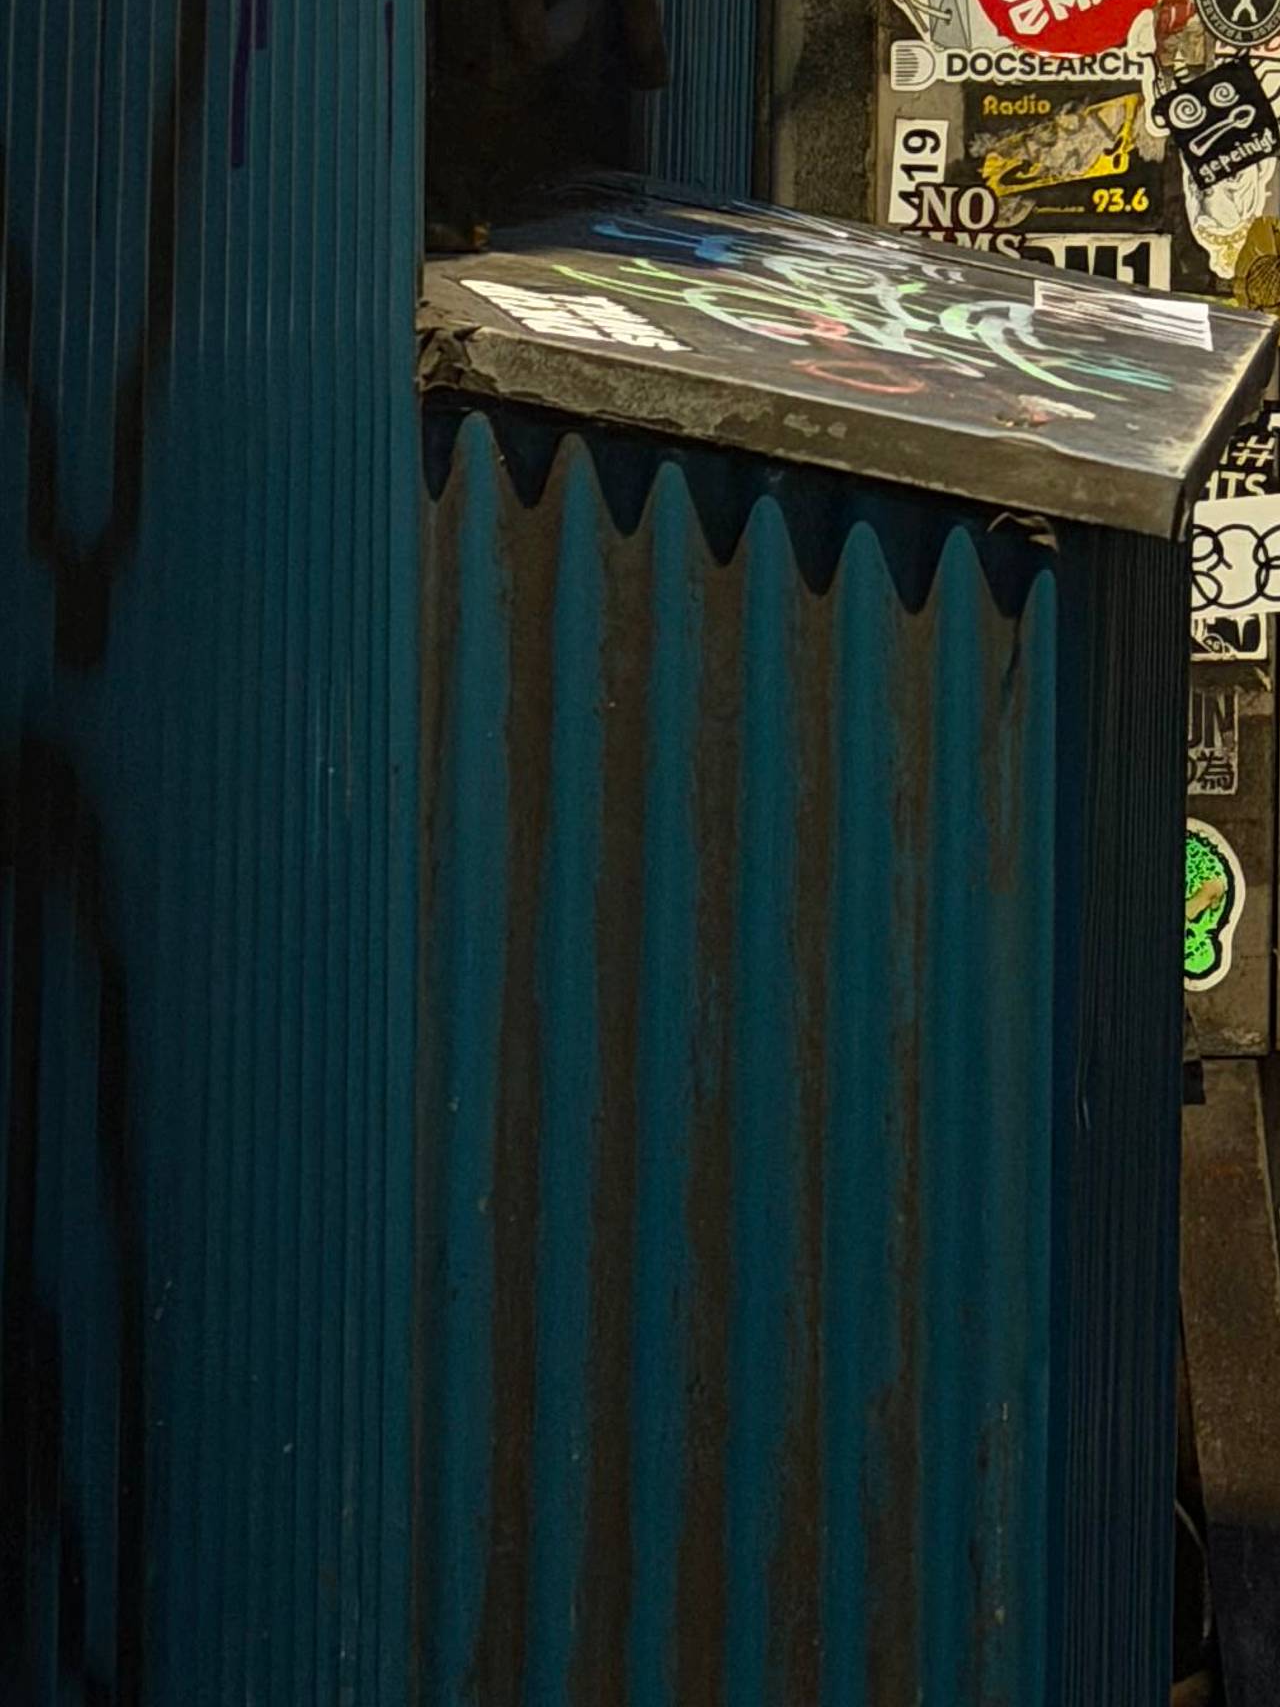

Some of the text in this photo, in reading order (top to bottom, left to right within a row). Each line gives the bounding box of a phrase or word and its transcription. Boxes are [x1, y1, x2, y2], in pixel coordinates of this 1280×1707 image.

[946, 51, 1145, 78] DOCSEARCH
[982, 93, 1051, 116] Radio
[1199, 126, 1277, 184] gepeinigt
[915, 185, 996, 231] NO
[1091, 187, 1150, 214] 93.6
